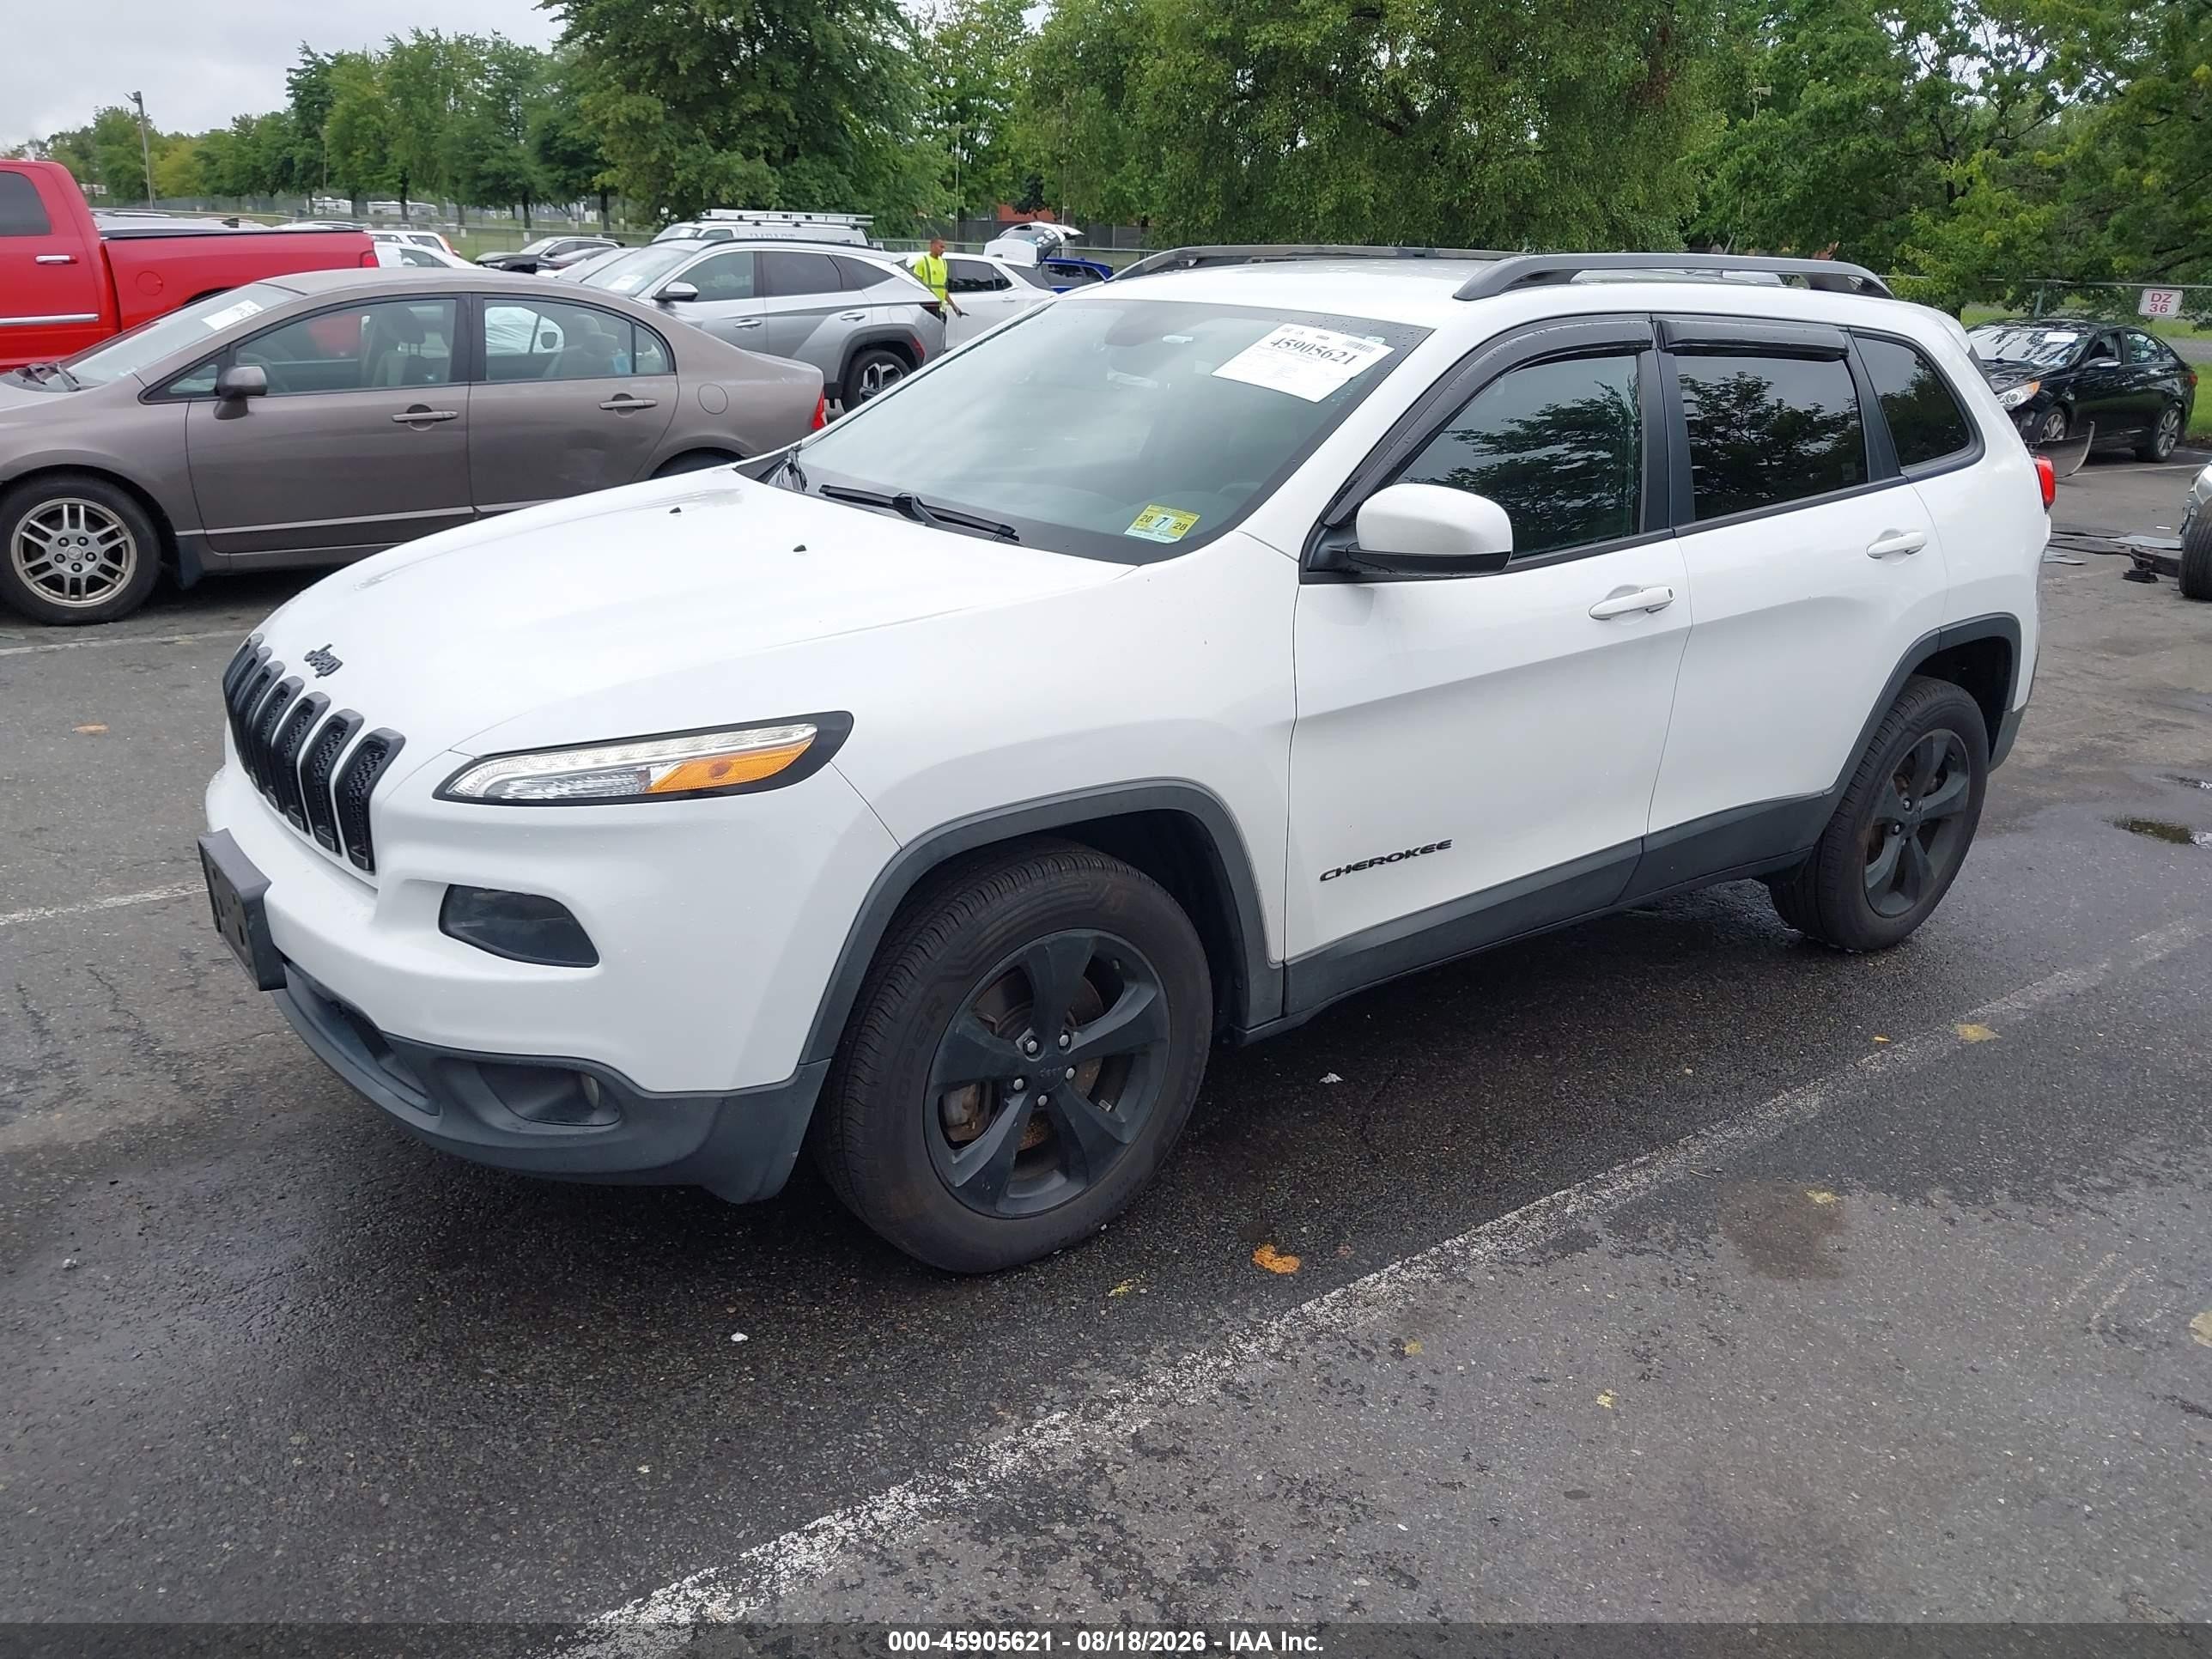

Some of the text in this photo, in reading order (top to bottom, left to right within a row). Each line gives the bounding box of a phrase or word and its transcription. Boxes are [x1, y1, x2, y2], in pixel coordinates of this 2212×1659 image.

[2150, 293, 2173, 303] DZ
[2149, 303, 2169, 313] 36
[1270, 337, 1358, 365] 45905621
[1139, 514, 1154, 523] 20
[304, 643, 343, 678] Jeep
[1320, 839, 1453, 881] CHEROKEE
